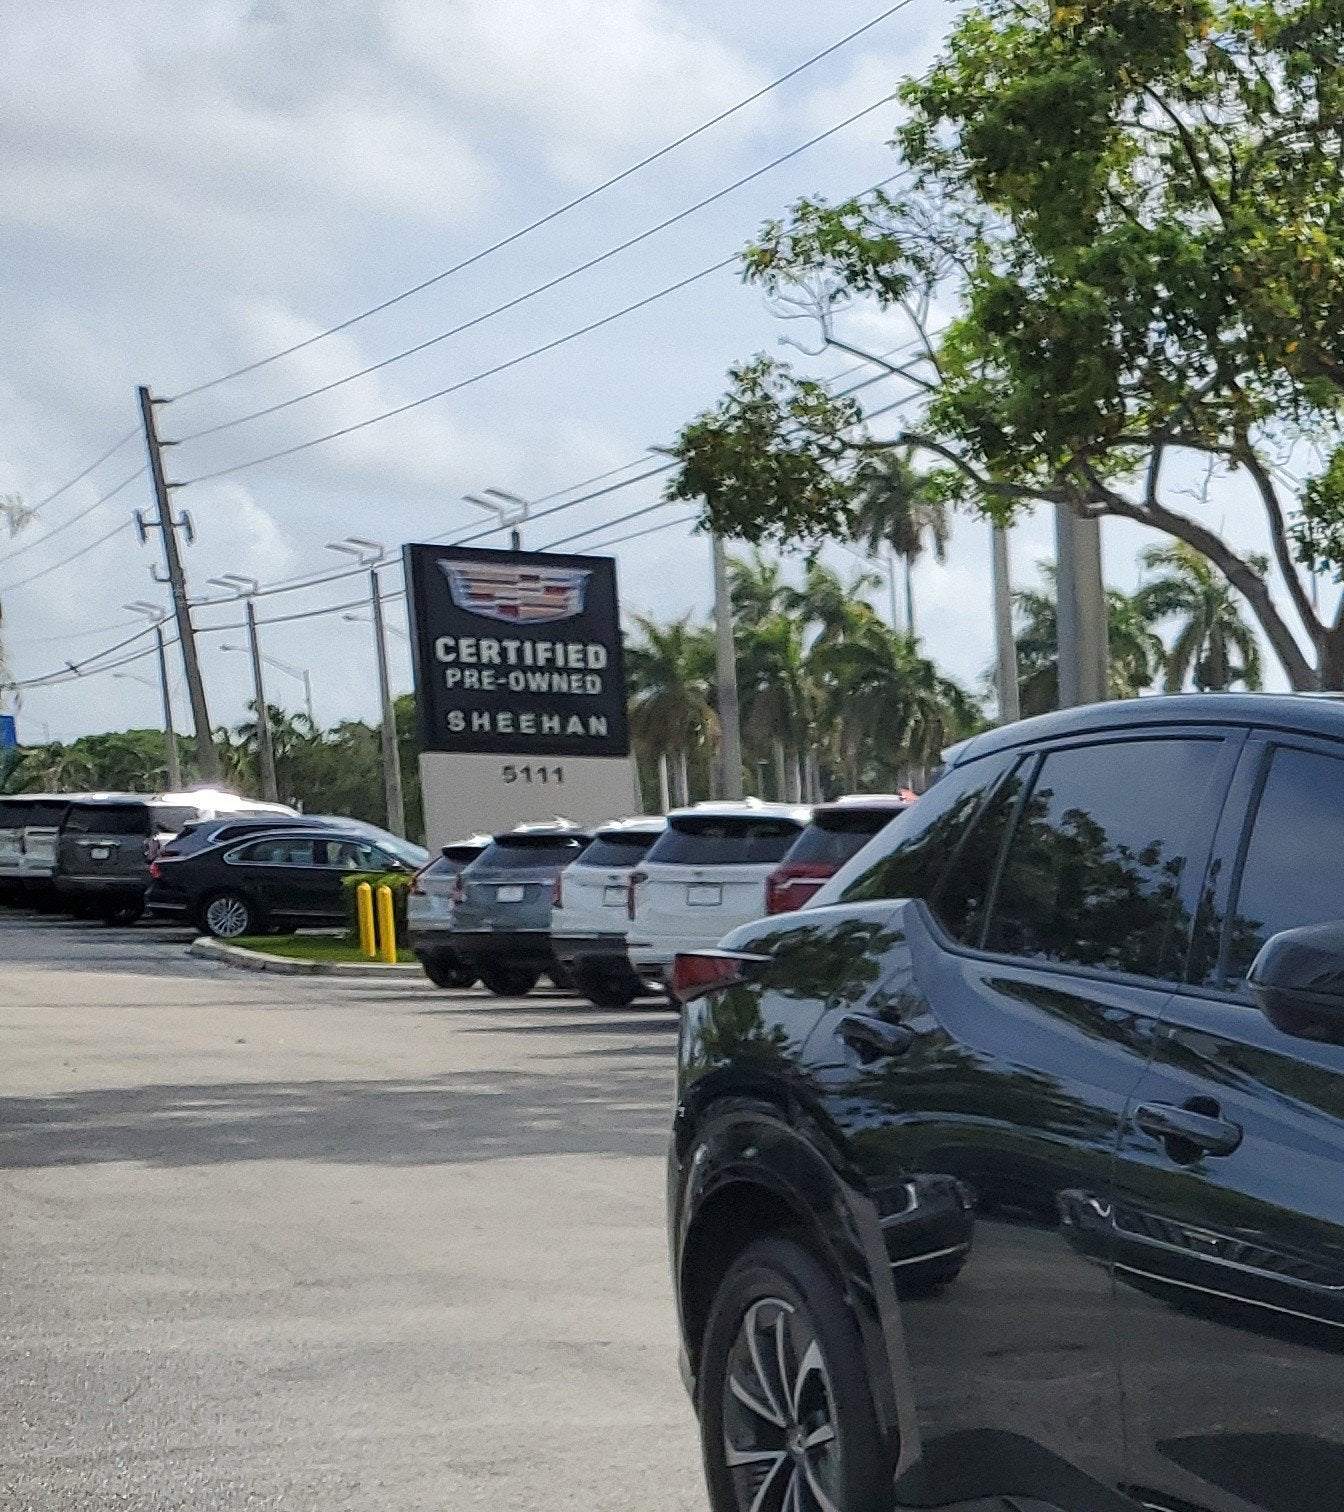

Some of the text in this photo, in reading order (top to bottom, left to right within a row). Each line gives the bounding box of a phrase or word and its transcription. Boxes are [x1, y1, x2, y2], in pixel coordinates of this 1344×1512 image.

[434, 635, 607, 670] CERTIFIED
[445, 667, 603, 695] PRE-OWNED
[447, 709, 609, 737] SHEEHAN
[502, 764, 565, 785] 5111
